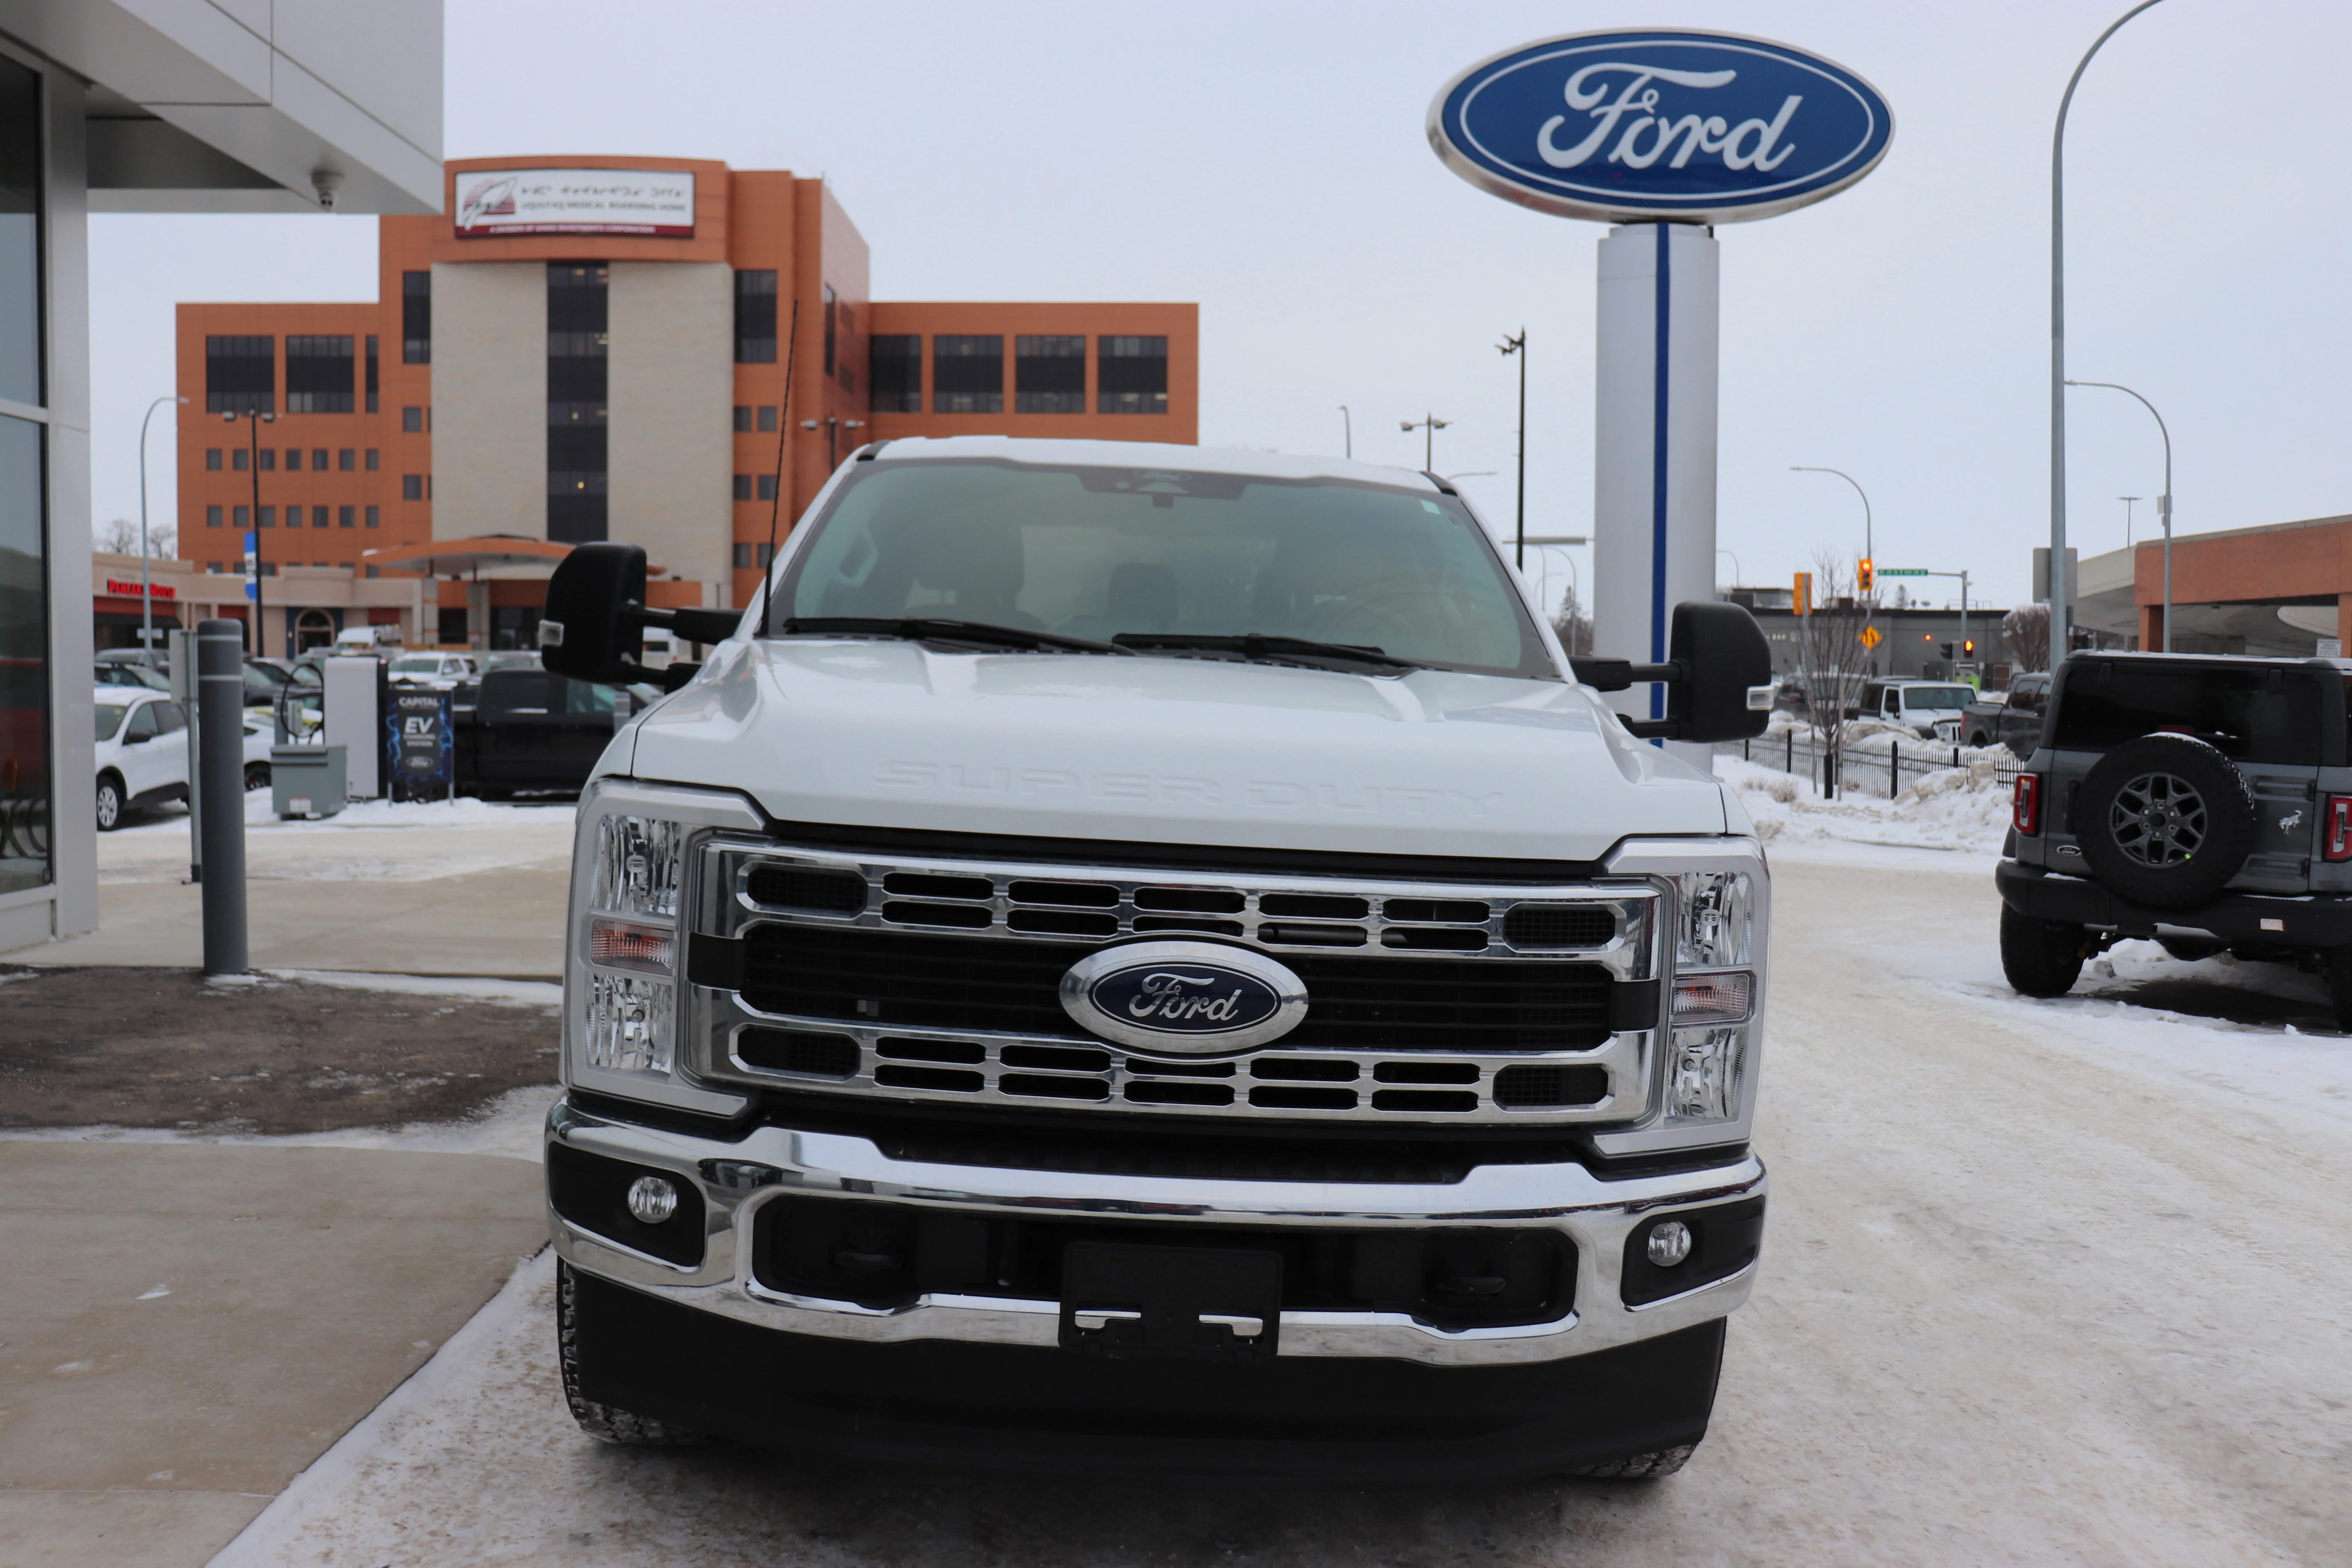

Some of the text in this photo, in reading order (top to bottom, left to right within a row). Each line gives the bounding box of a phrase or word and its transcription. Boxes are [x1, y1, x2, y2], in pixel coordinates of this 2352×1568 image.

[1537, 62, 1803, 172] Ford
[108, 579, 143, 595] PANCAK
[399, 697, 440, 707] CAPITAL
[405, 717, 434, 733] EV
[875, 760, 1503, 816] SUPER DUTY
[1129, 973, 1242, 1021] Ford
